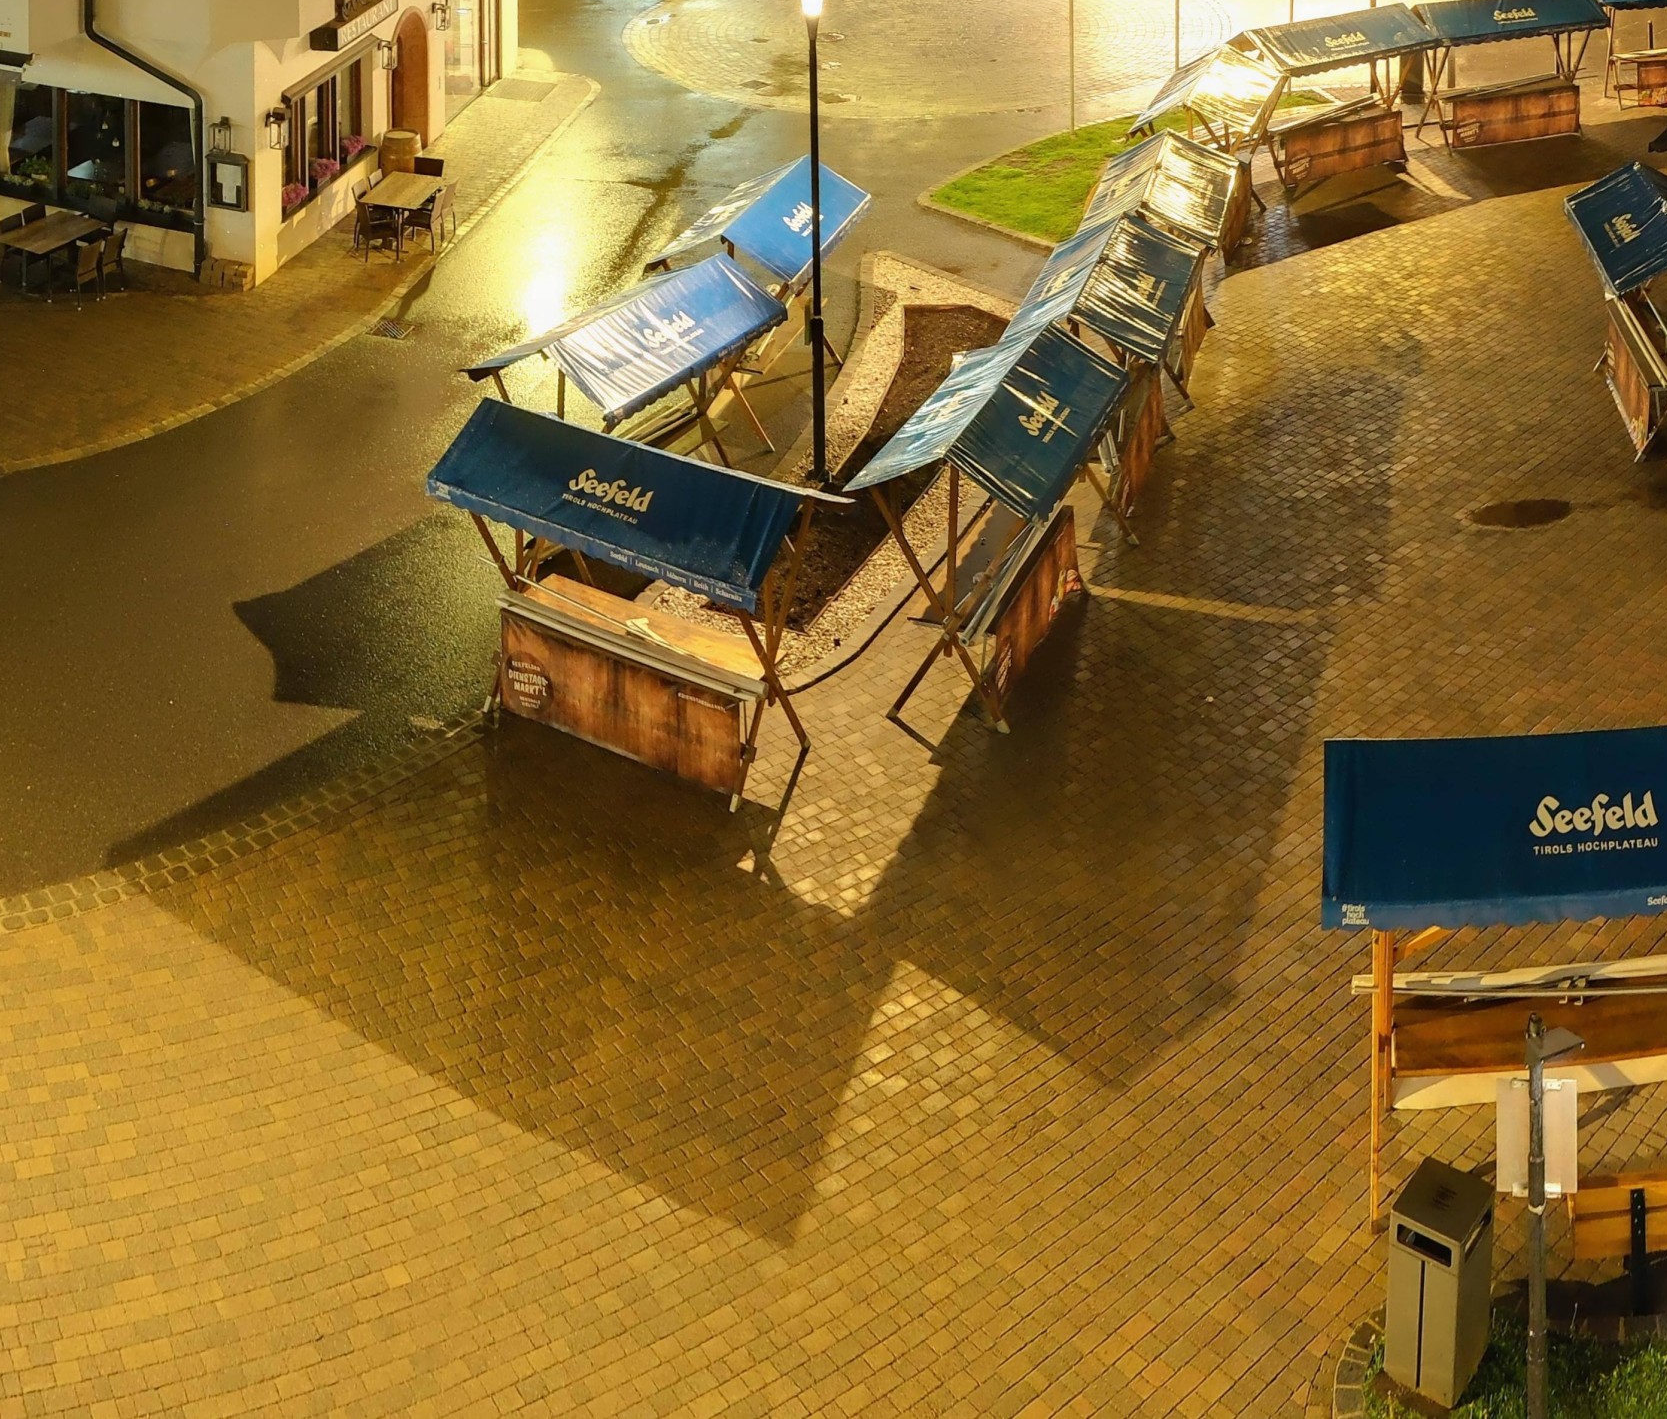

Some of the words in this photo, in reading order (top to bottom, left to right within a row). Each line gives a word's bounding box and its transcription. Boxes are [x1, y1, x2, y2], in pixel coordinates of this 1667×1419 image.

[1493, 8, 1536, 21] Seefeld
[1324, 32, 1367, 48] Seefeld
[569, 468, 653, 513] Seefeld
[587, 500, 638, 524] HOCHPLATEAU
[1529, 790, 1659, 838] Seefeld
[1533, 843, 1573, 856] TIROLS
[1577, 837, 1659, 853] HOCHPLATEAU
